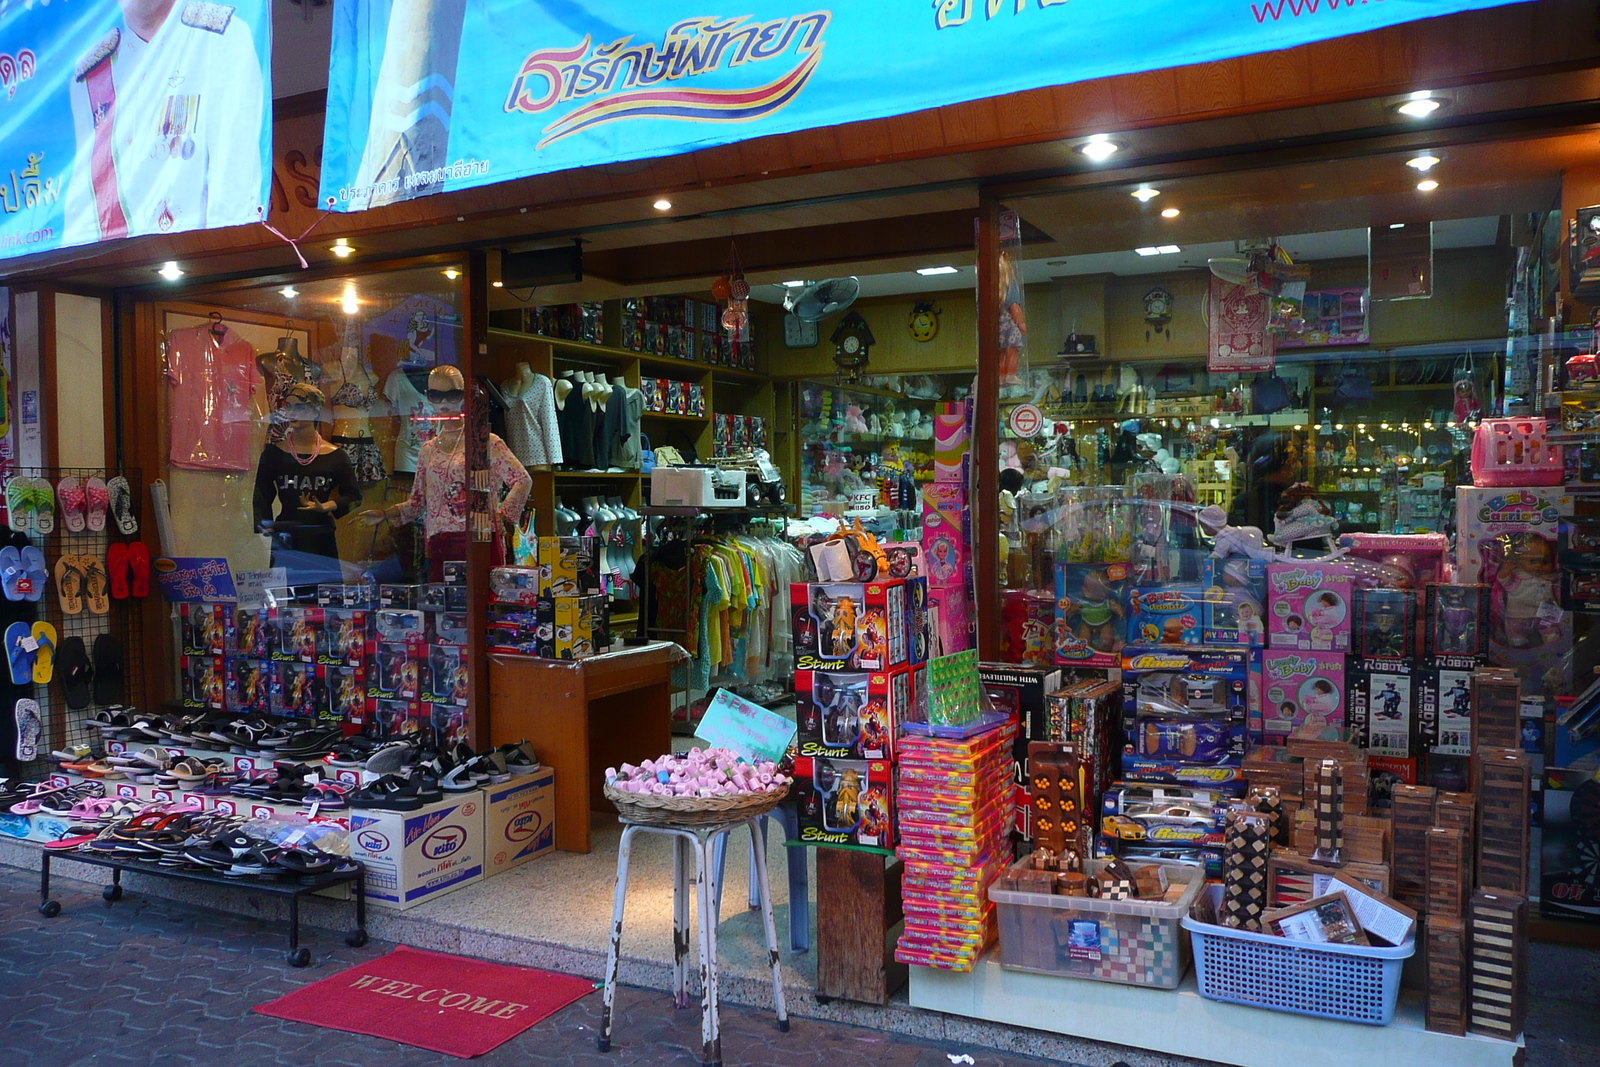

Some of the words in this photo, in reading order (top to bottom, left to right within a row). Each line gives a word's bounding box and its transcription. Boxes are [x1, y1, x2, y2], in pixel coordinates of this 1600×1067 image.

[1484, 490, 1551, 512] Baby
[1477, 506, 1560, 523] Carriage
[1286, 577, 1321, 590] Baby
[797, 655, 845, 671] Stunt
[1138, 656, 1189, 669] Racer
[1364, 658, 1403, 672] ROBOT
[1435, 655, 1476, 669] ROBOT
[1280, 664, 1316, 678] Baby
[1020, 676, 1038, 684] WITH
[1419, 686, 1435, 735] ROBOT
[801, 742, 849, 758] Stunt
[802, 827, 849, 843] Stunt
[349, 974, 530, 1020] WELCOME
